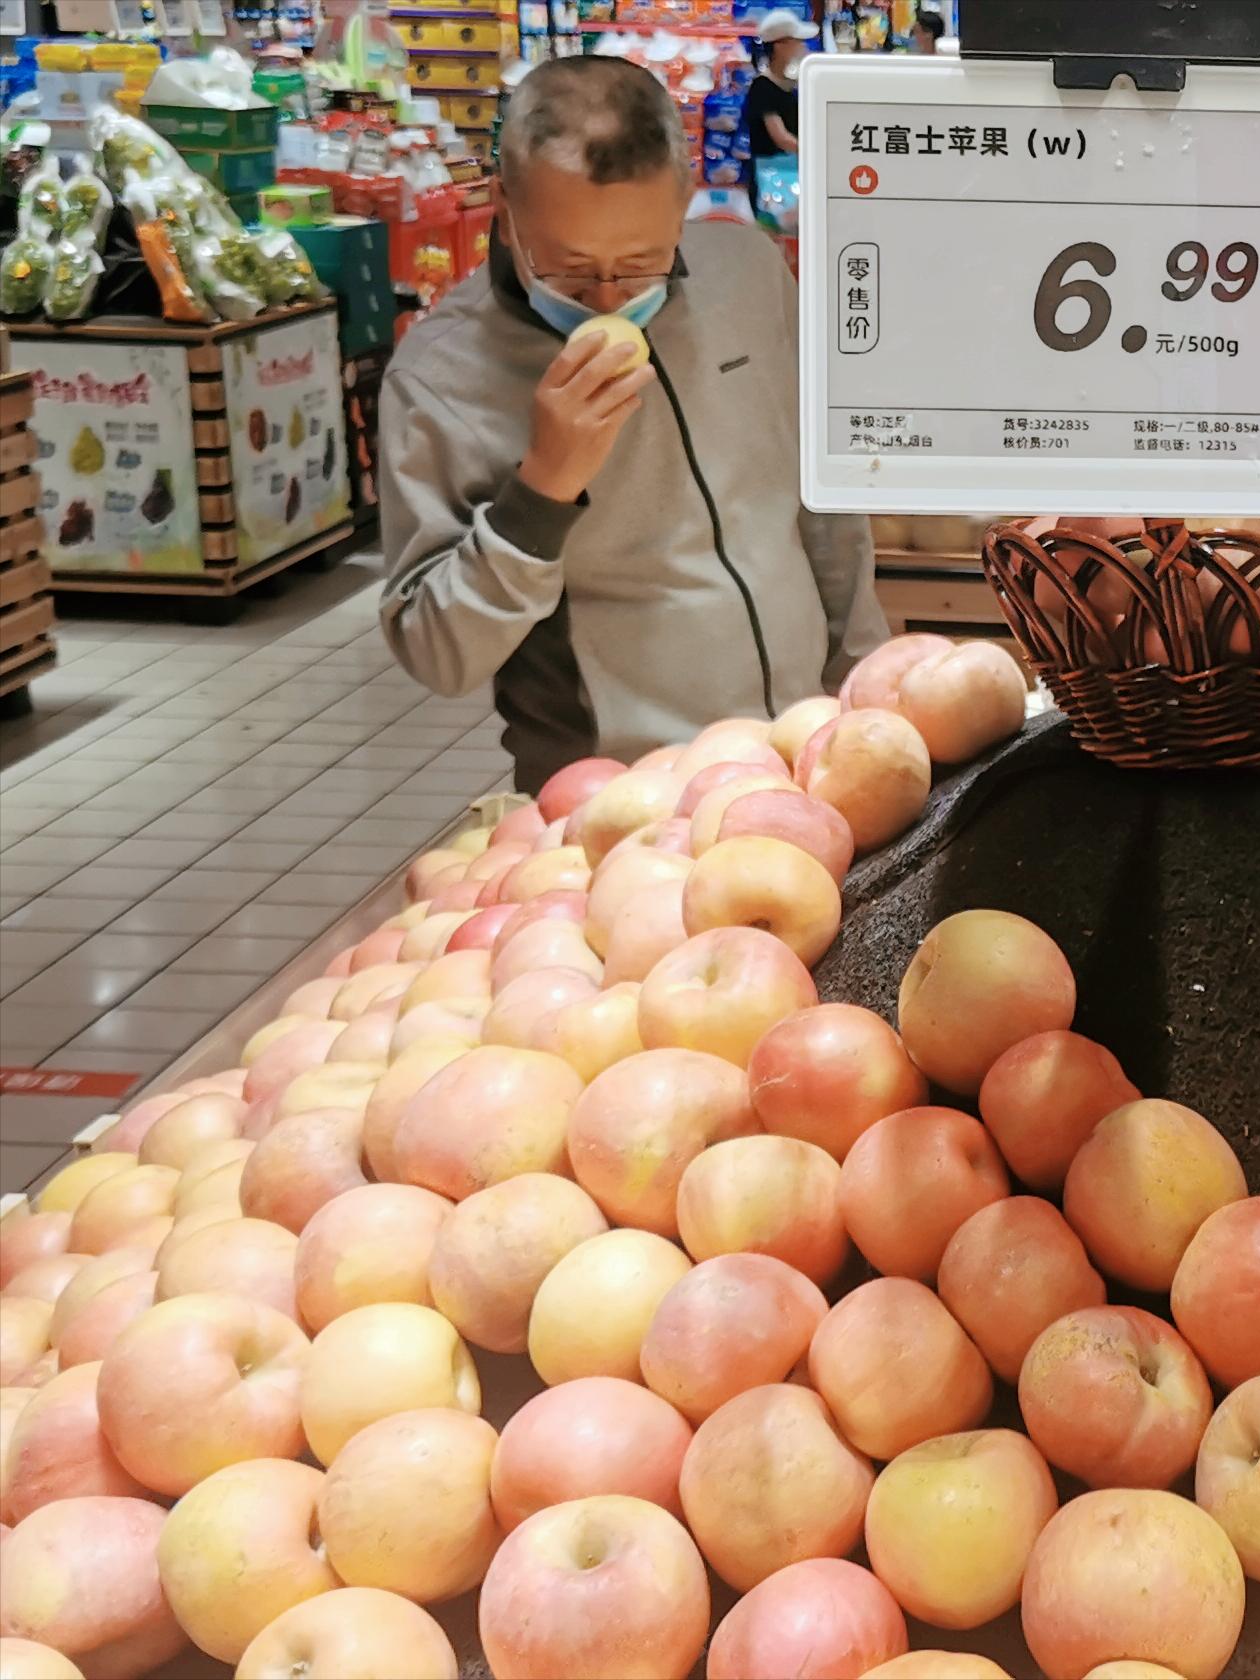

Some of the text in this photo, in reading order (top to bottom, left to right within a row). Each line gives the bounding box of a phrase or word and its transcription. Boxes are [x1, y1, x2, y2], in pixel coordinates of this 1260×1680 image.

[846, 258, 870, 340] 零售价
[1155, 333, 1239, 357] 元/500g
[1003, 417, 1090, 431] 货号:3242835
[1003, 436, 1070, 449] 核价员:701
